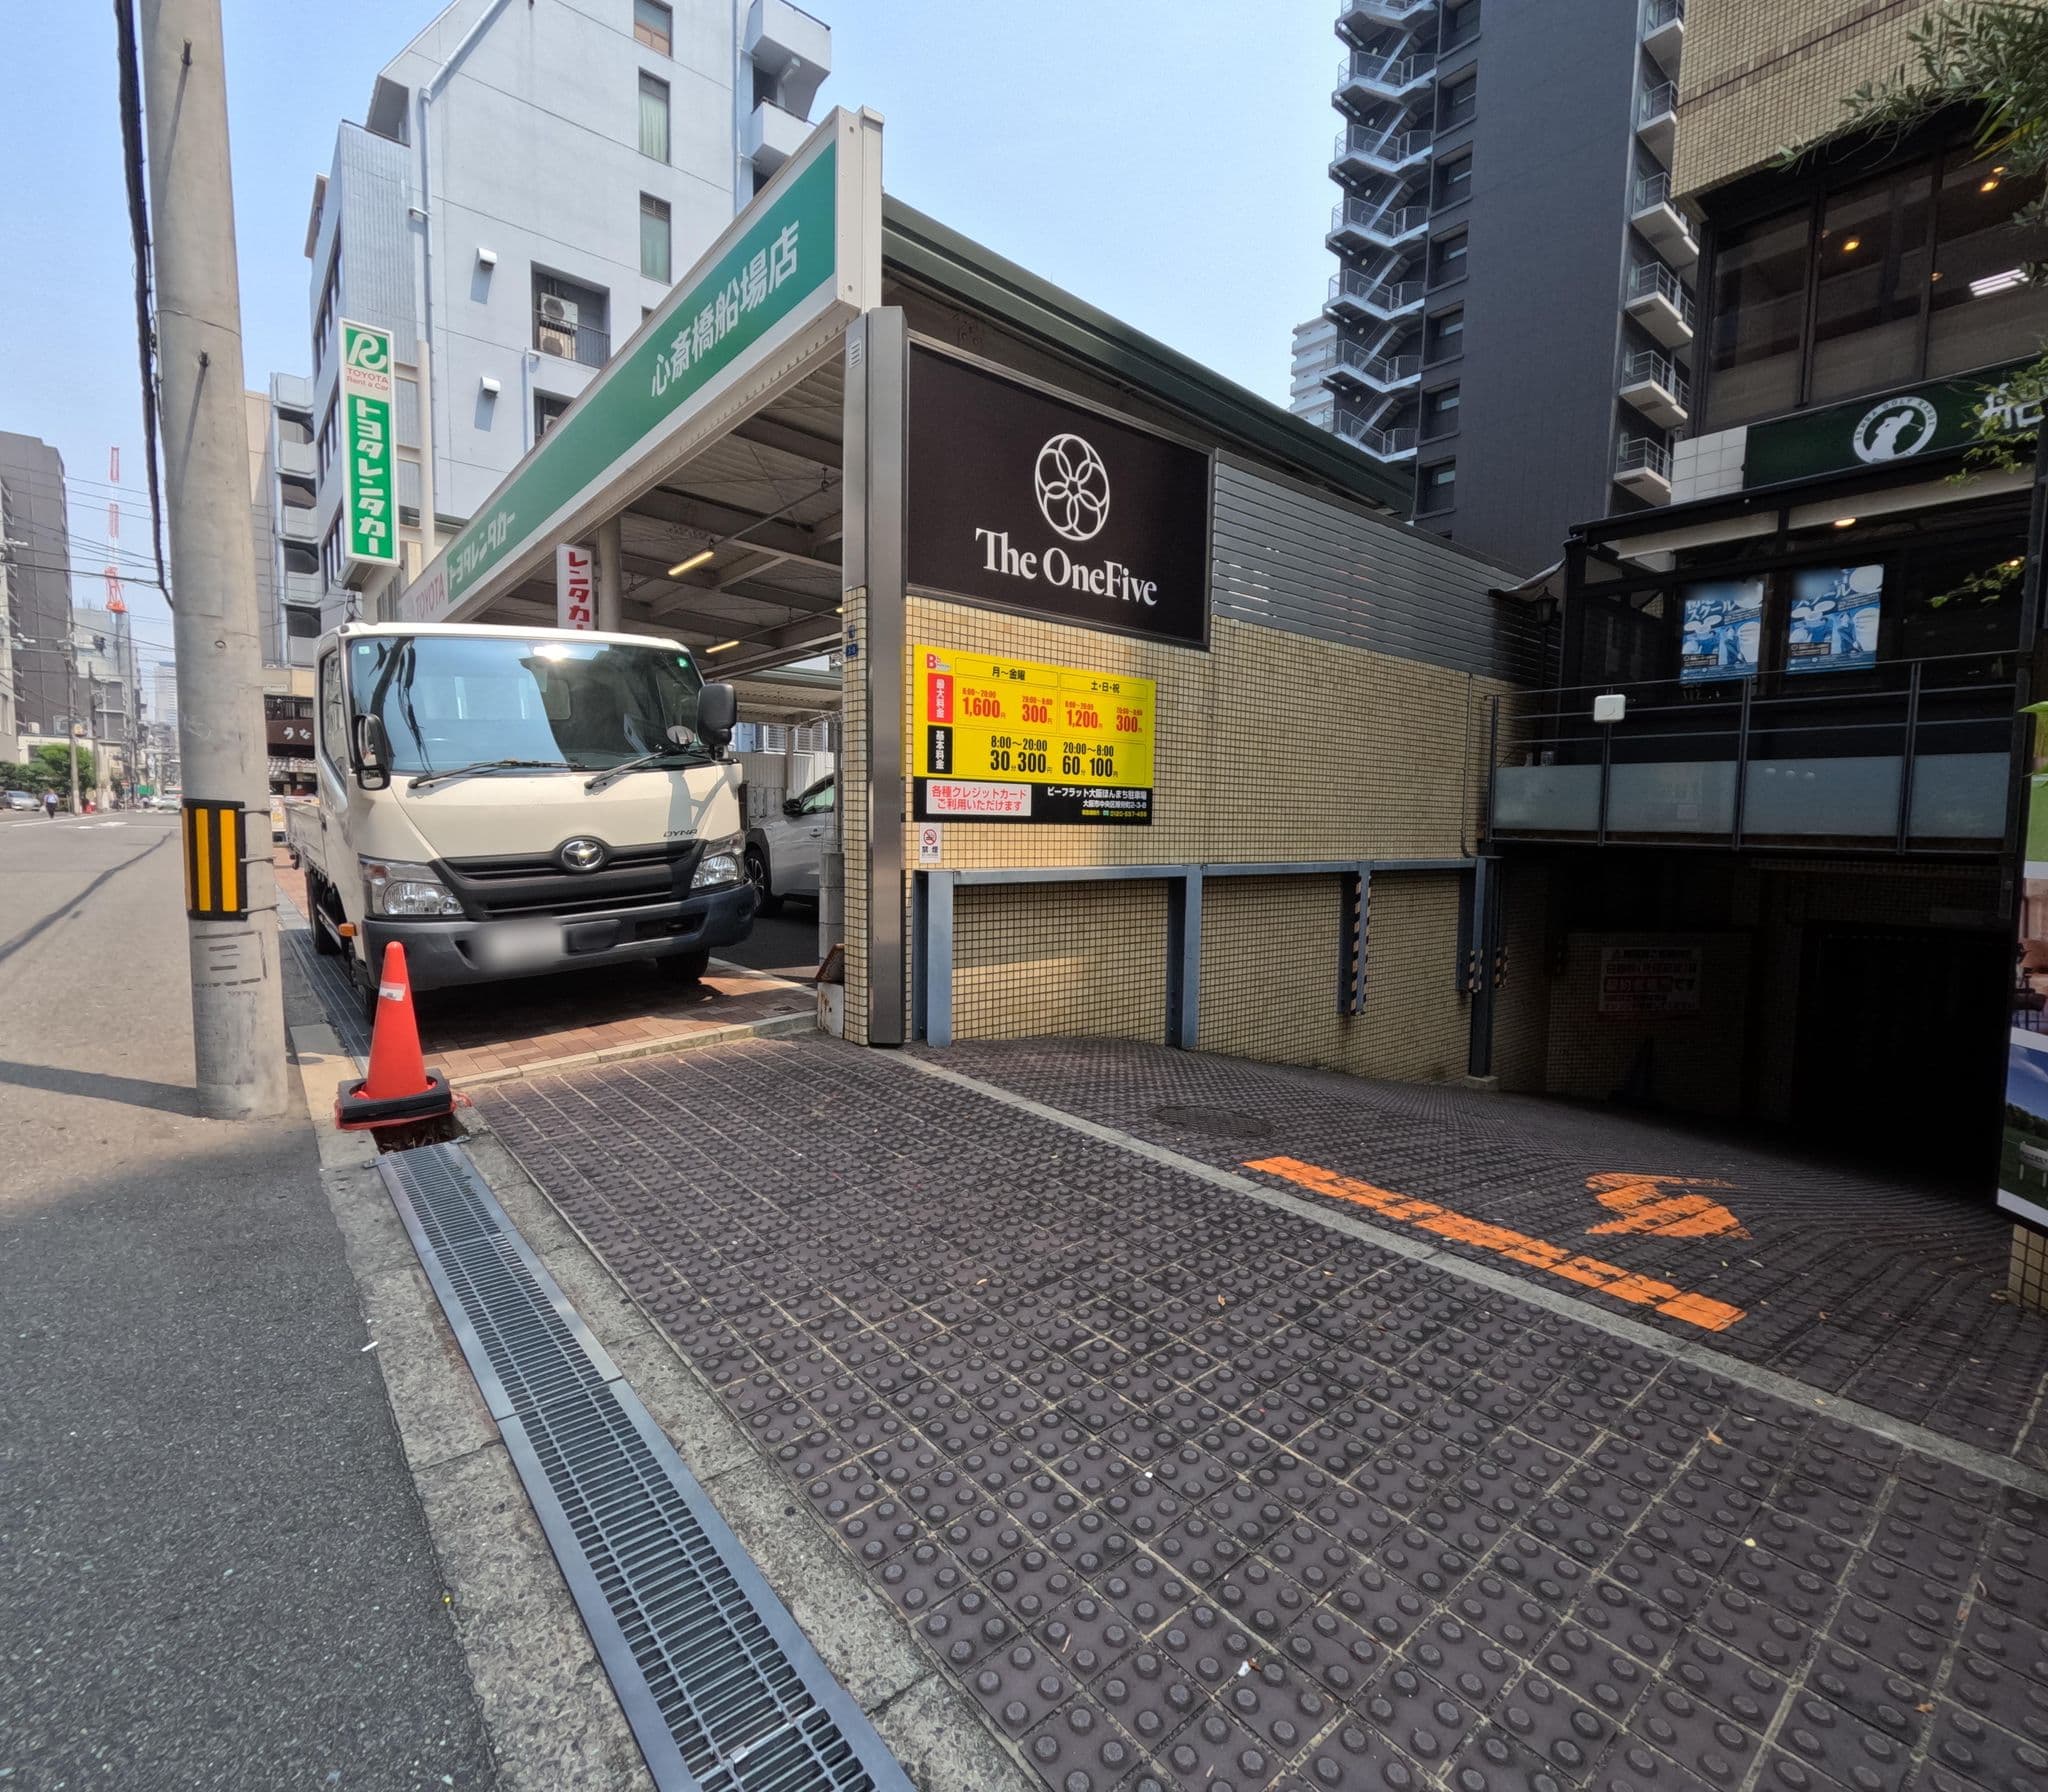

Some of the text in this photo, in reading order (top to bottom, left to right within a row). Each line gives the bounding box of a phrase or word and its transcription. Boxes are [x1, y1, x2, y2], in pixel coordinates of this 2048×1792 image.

[651, 219, 800, 398] 心斎橋船場店
[347, 368, 389, 384] TOYOTA
[347, 376, 366, 385] Rent
[375, 382, 389, 391] Car
[356, 398, 386, 554] トヨタレンタカー
[449, 511, 516, 591] トヨタレンタカー
[975, 527, 1158, 606] The OneFive
[415, 574, 446, 621] TOYOTA
[931, 785, 1027, 800] 各種クレジットカード
[937, 799, 1022, 812] ご利用いただけます
[663, 828, 698, 838] DYNA
